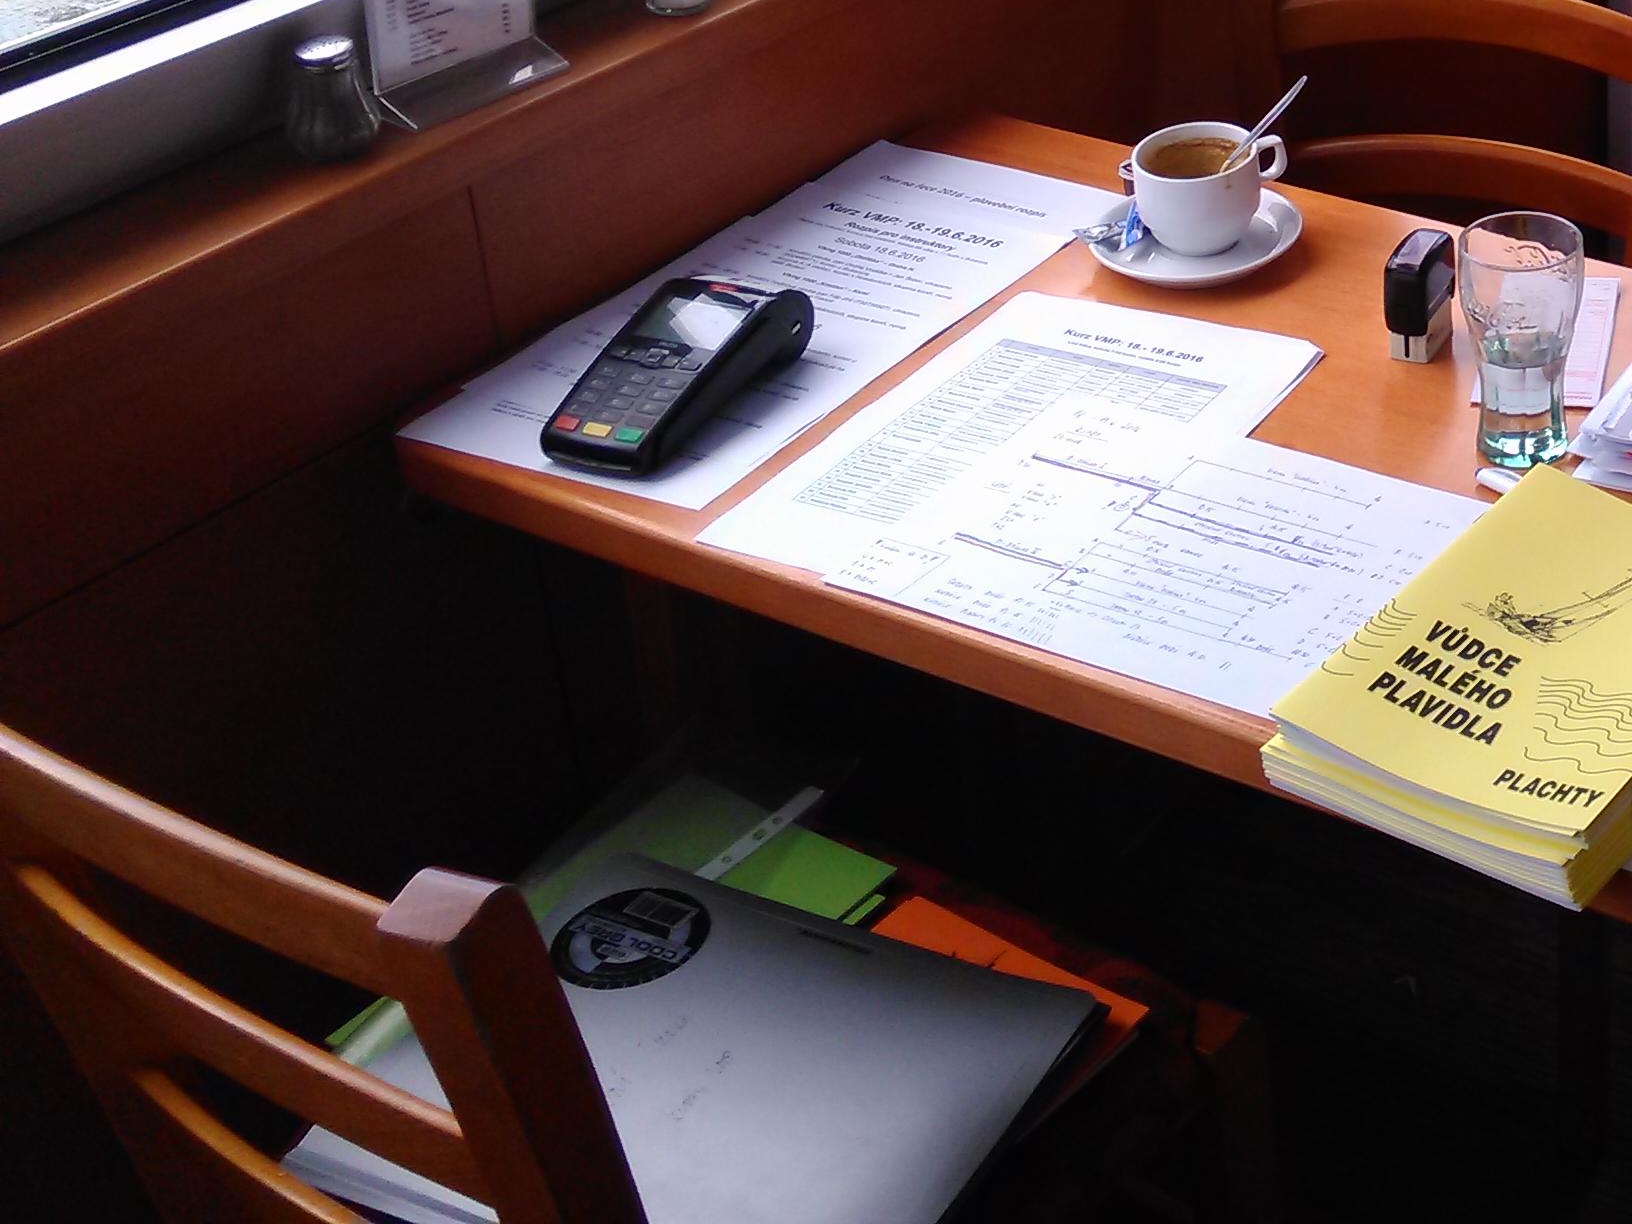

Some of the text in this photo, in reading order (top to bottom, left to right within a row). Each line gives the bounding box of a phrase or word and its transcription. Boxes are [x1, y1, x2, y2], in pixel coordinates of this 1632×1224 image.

[823, 201, 1005, 249] Kurz VMP: 18.-19.6.2016
[844, 221, 957, 253] Rozpis pro instruktory
[834, 236, 871, 251] Sobota
[874, 245, 926, 263] 18.6.2016
[1064, 328, 1092, 341] Kurz
[1094, 334, 1125, 347] VMP:
[1150, 346, 1205, 363] 19.6.2016
[1425, 620, 1522, 677] VŮDCE
[1394, 644, 1513, 710] MALÉHO
[1367, 670, 1503, 746] PLAVIDLA
[1493, 768, 1605, 808] PLACHTY
[628, 935, 678, 962] COOL
